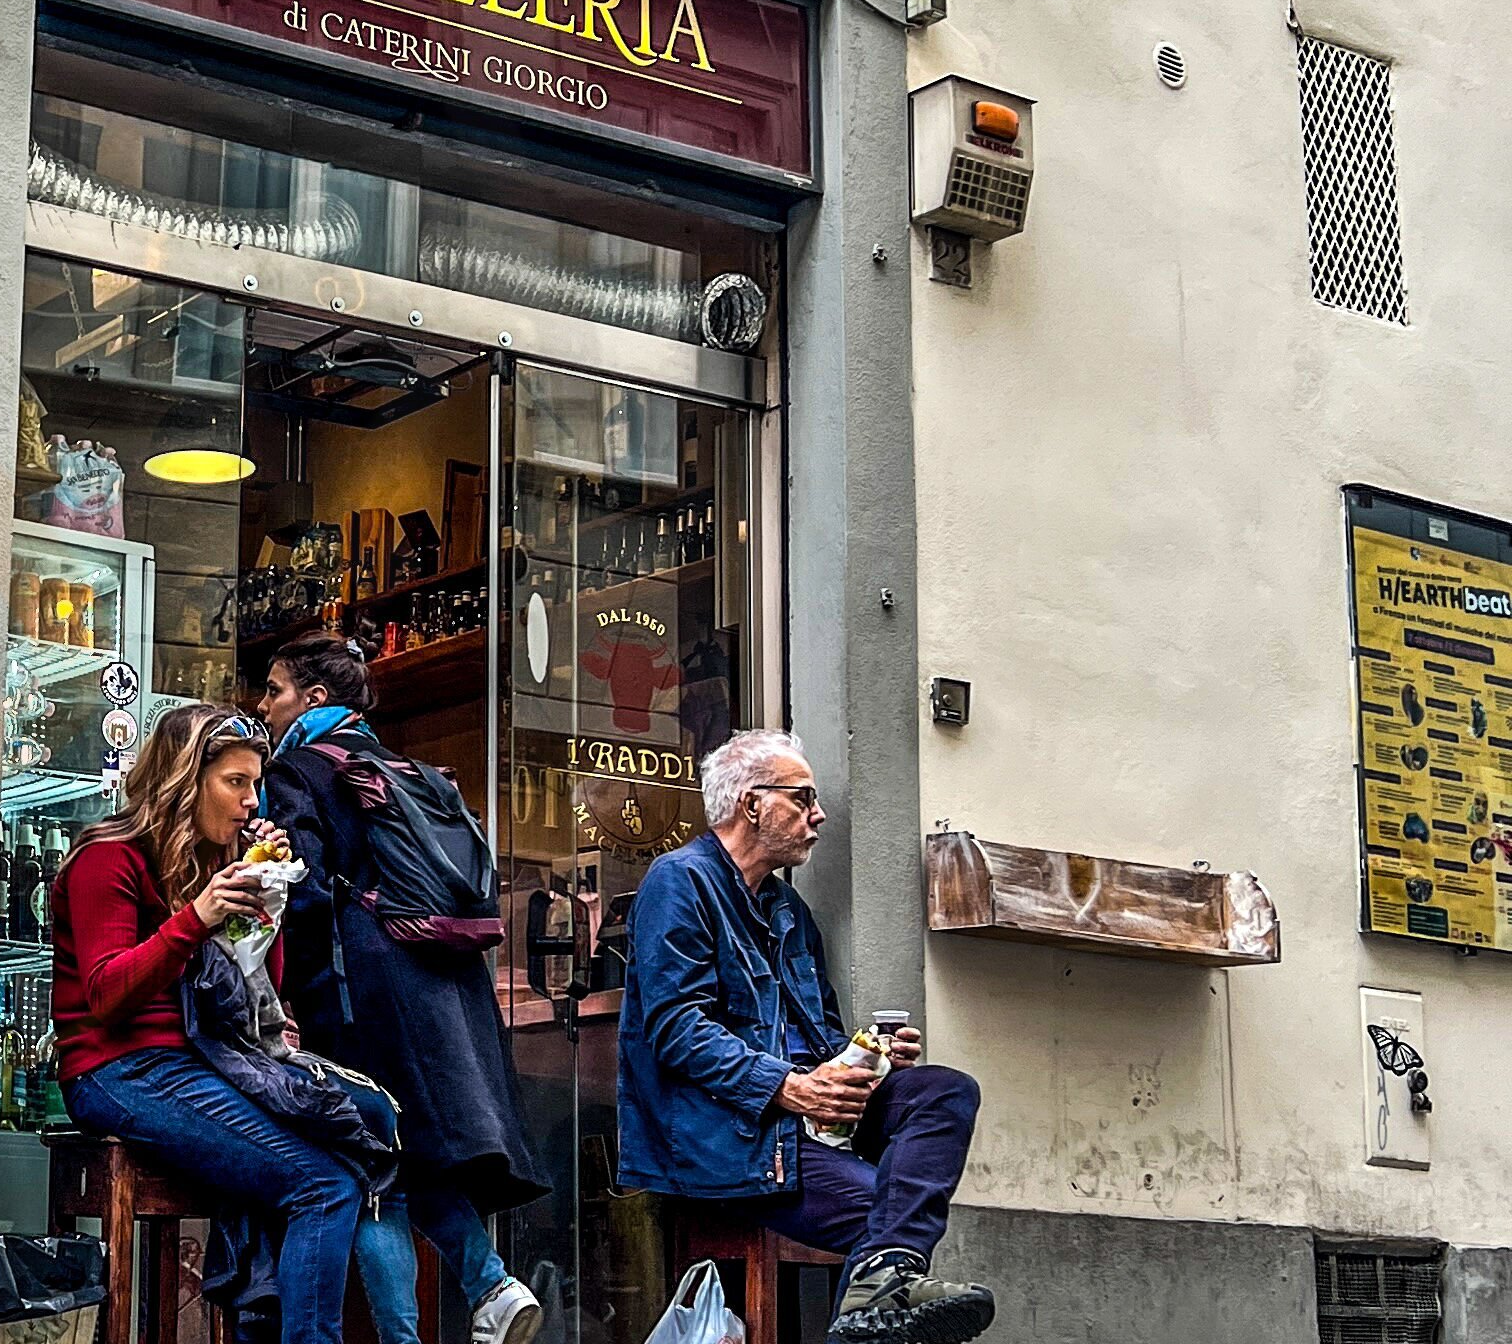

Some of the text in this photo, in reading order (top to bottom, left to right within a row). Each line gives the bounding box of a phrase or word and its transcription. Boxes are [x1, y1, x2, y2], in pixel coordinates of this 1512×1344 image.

[283, 0, 609, 111] di CATERINI GIORGIO
[935, 238, 969, 278] 22
[596, 608, 631, 628] DAL
[572, 801, 692, 864] MACEERIA
